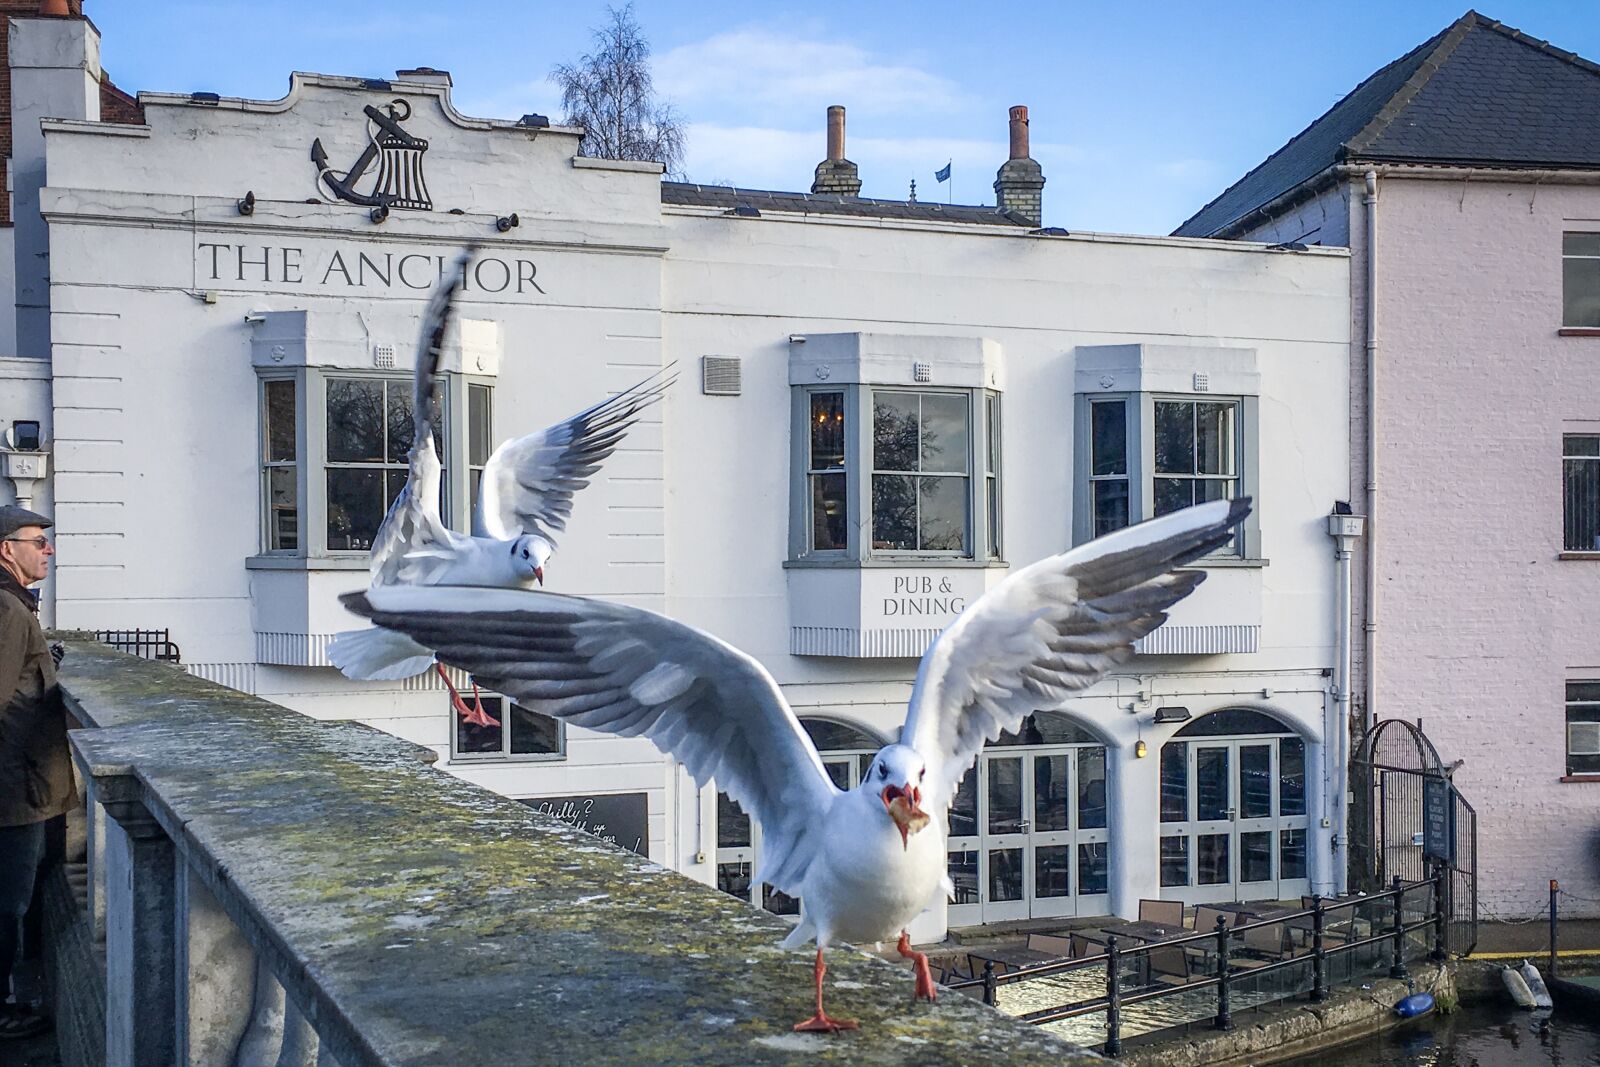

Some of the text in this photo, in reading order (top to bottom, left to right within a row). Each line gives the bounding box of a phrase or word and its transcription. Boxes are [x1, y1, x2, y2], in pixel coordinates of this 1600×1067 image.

[198, 242, 547, 295] THE ANCHOR
[894, 576, 952, 594] PUB &
[883, 597, 965, 616] DINING
